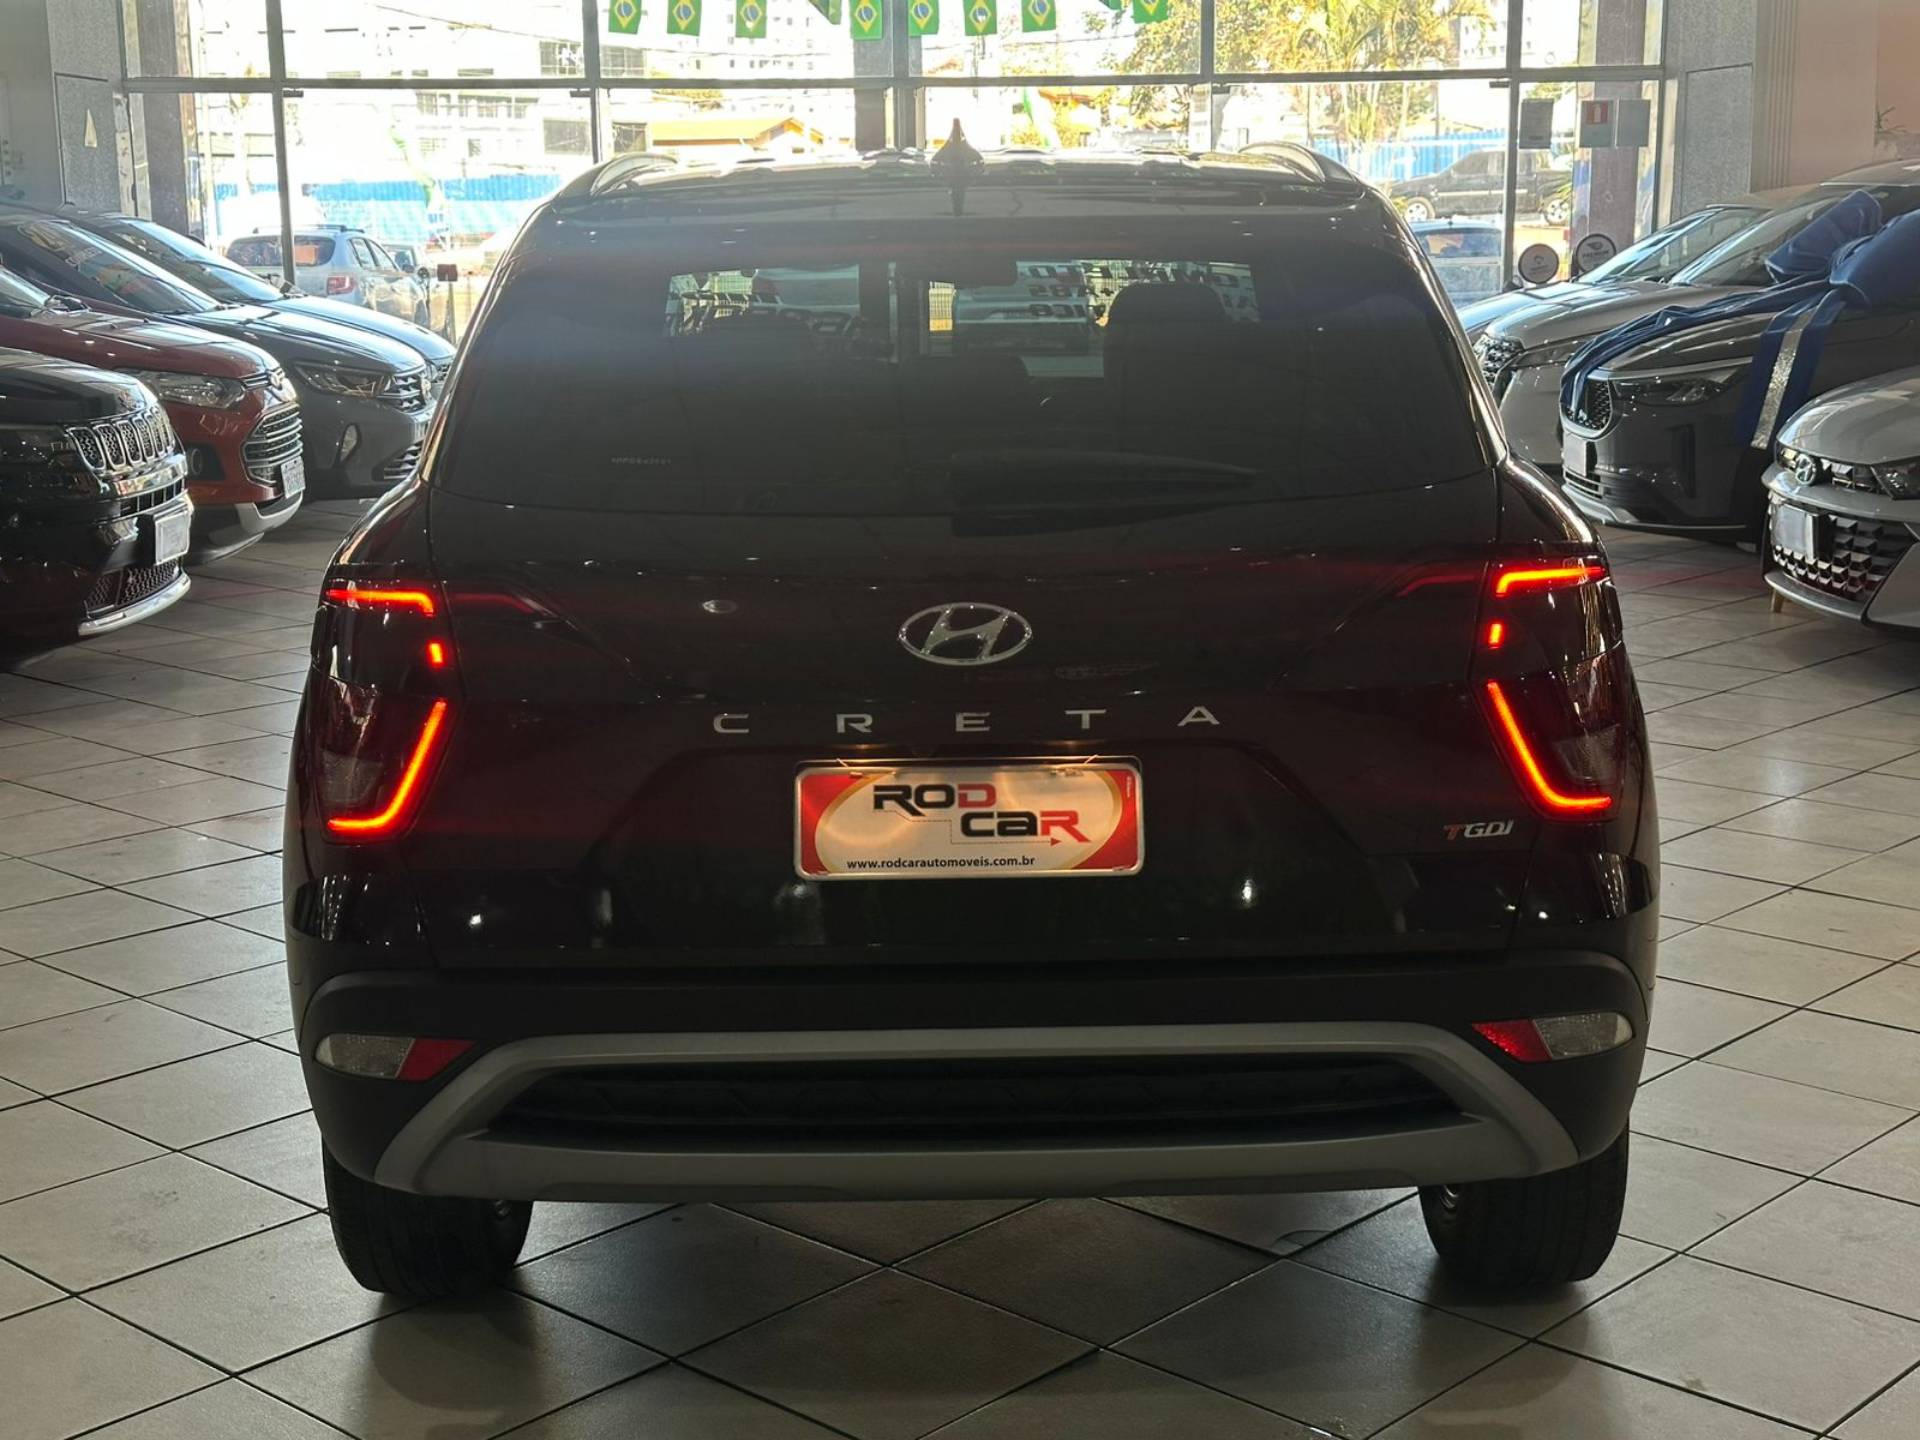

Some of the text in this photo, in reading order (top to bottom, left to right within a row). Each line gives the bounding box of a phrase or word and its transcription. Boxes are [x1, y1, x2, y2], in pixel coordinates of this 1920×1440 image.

[713, 705, 1220, 734] CRETA
[873, 784, 997, 817] ROD
[1443, 819, 1514, 841] TGDI
[846, 855, 1036, 870] www.rodcarautomoveis.com.br
